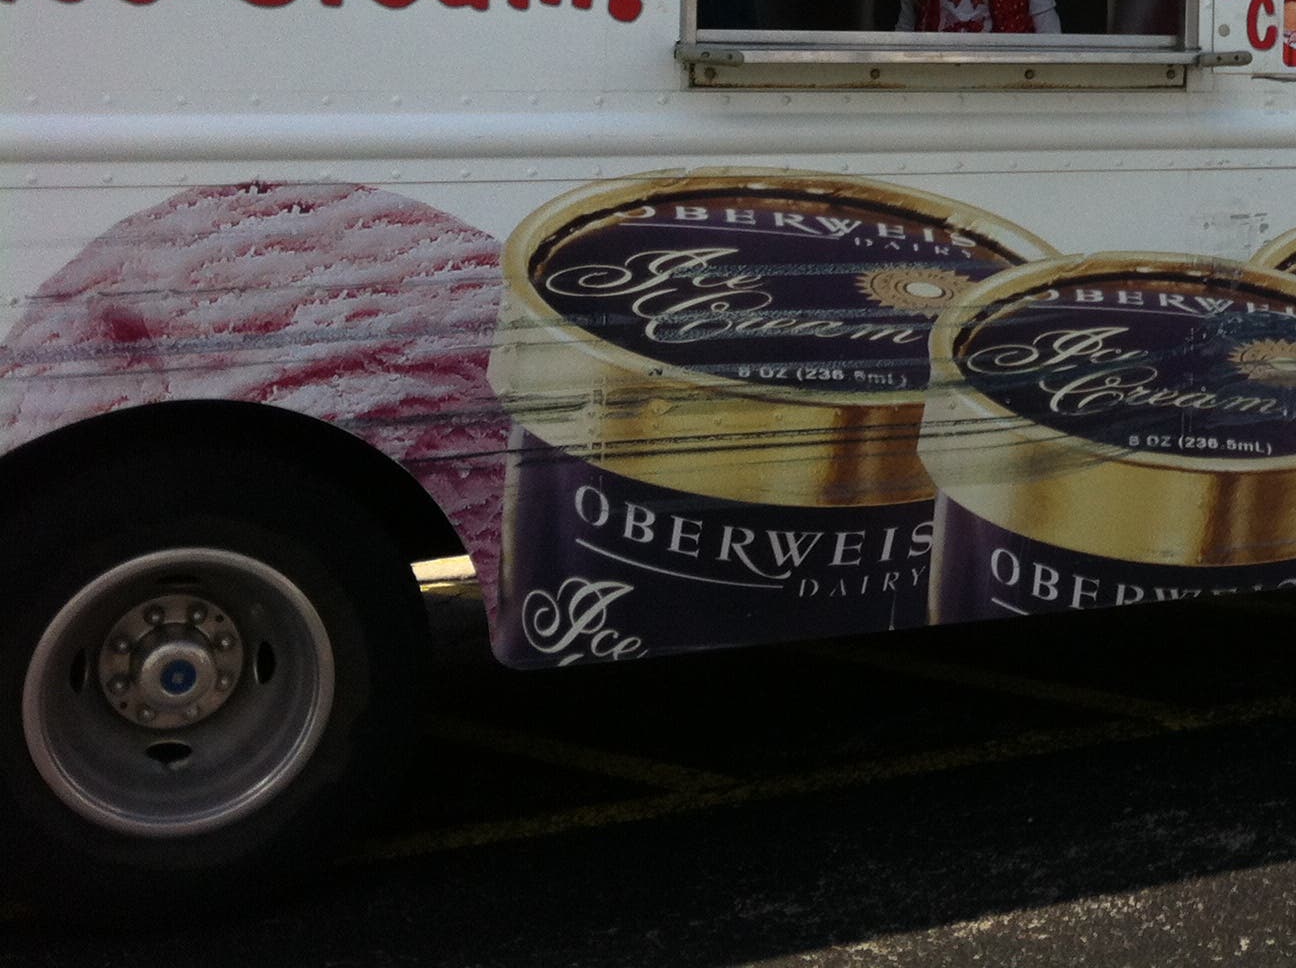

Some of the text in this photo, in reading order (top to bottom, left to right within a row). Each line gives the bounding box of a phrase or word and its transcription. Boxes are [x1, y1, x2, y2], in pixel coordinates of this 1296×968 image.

[614, 204, 976, 248] OBERWEIS
[546, 248, 766, 297] Ice
[632, 288, 922, 344] Cream
[759, 366, 788, 379] OZ
[1039, 365, 1284, 416] Cream
[1147, 435, 1172, 448] OZ
[574, 485, 934, 579] OBERWEIS
[799, 565, 927, 597] DAIRY
[522, 577, 649, 661] Ice
